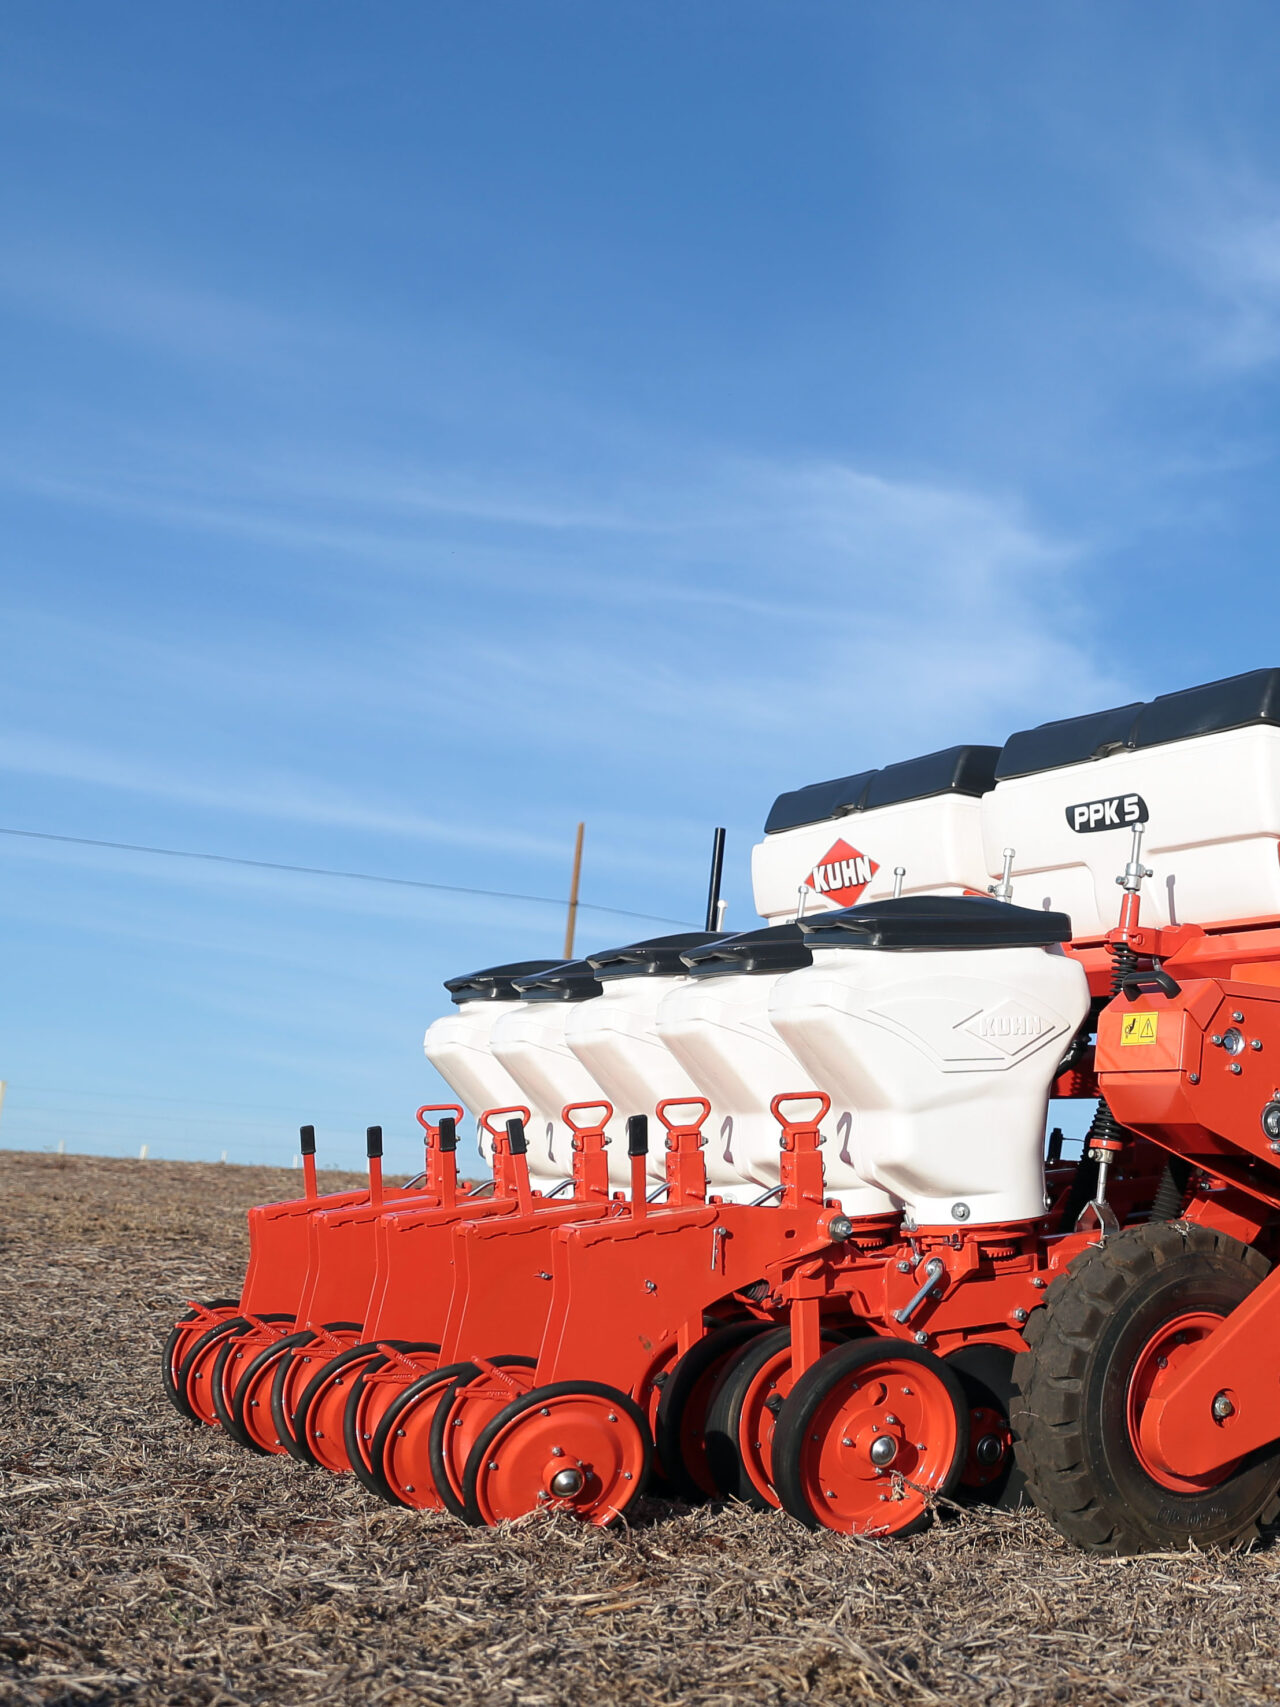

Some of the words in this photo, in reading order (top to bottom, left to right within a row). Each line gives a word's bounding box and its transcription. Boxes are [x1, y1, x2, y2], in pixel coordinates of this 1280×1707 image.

[1074, 799, 1120, 831] PPK
[1123, 795, 1140, 822] 5
[811, 854, 873, 894] KUHN
[981, 1015, 1042, 1037] KUHN
